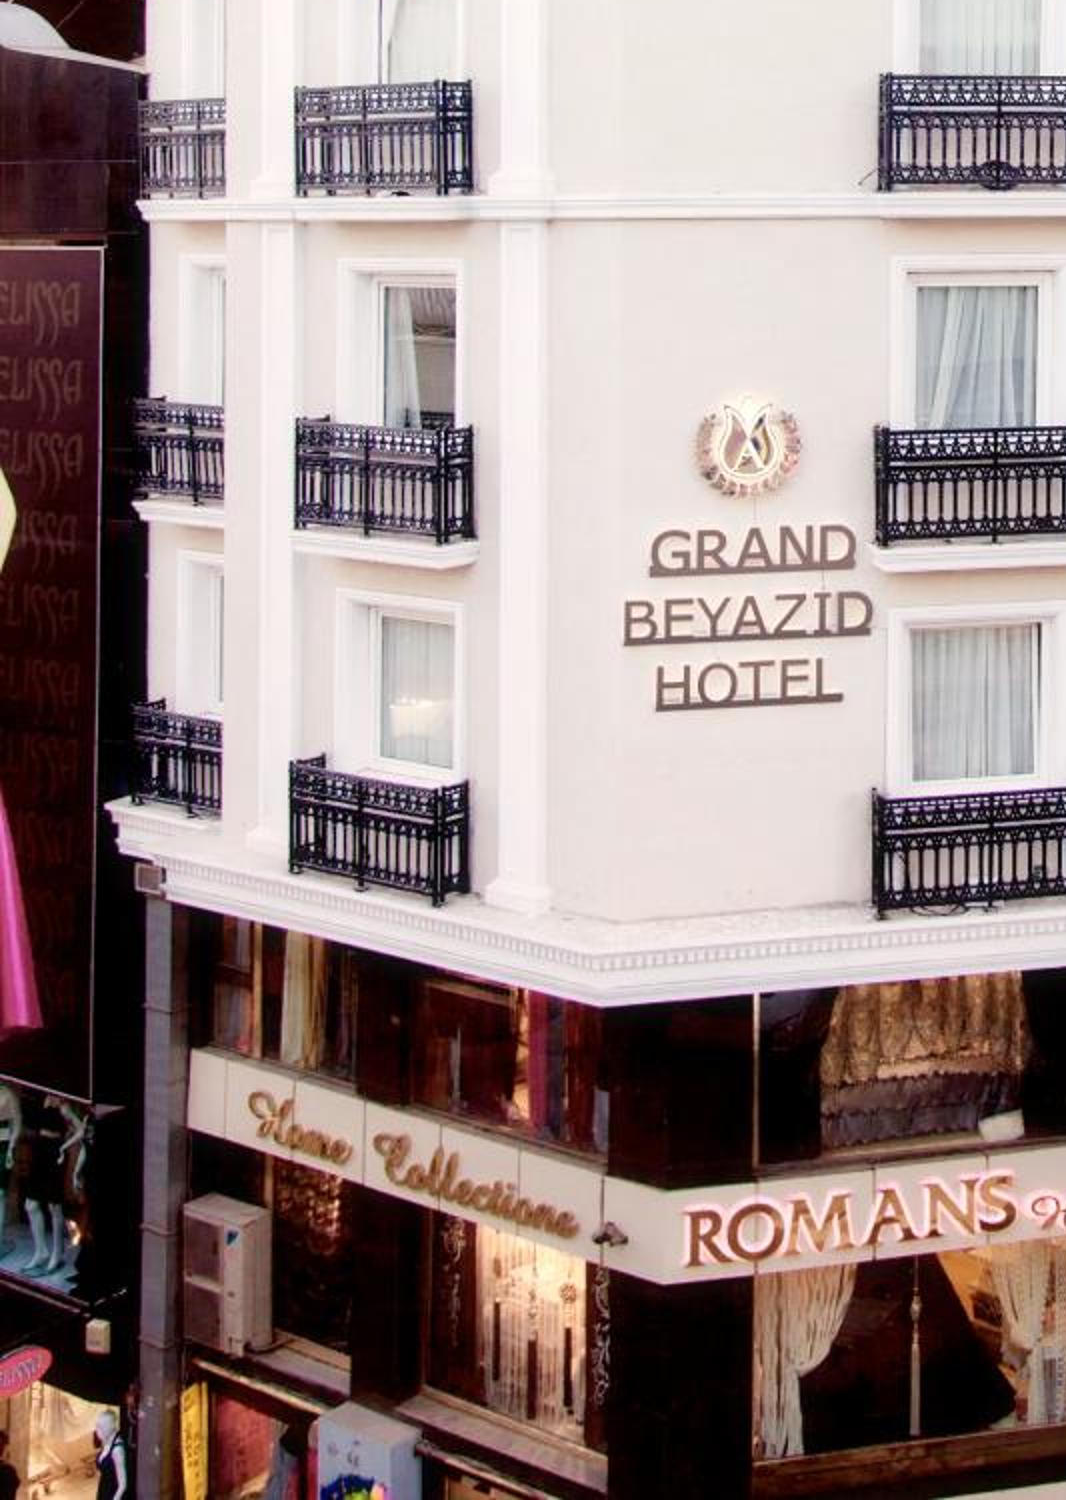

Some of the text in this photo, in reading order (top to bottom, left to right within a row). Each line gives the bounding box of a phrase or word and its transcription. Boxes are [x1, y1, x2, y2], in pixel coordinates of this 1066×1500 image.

[650, 524, 857, 578] GRAND
[623, 590, 874, 647] BEYAZID
[655, 657, 844, 712] HOTEL
[248, 1090, 352, 1166] Home
[684, 1173, 1019, 1268] ROMANS
